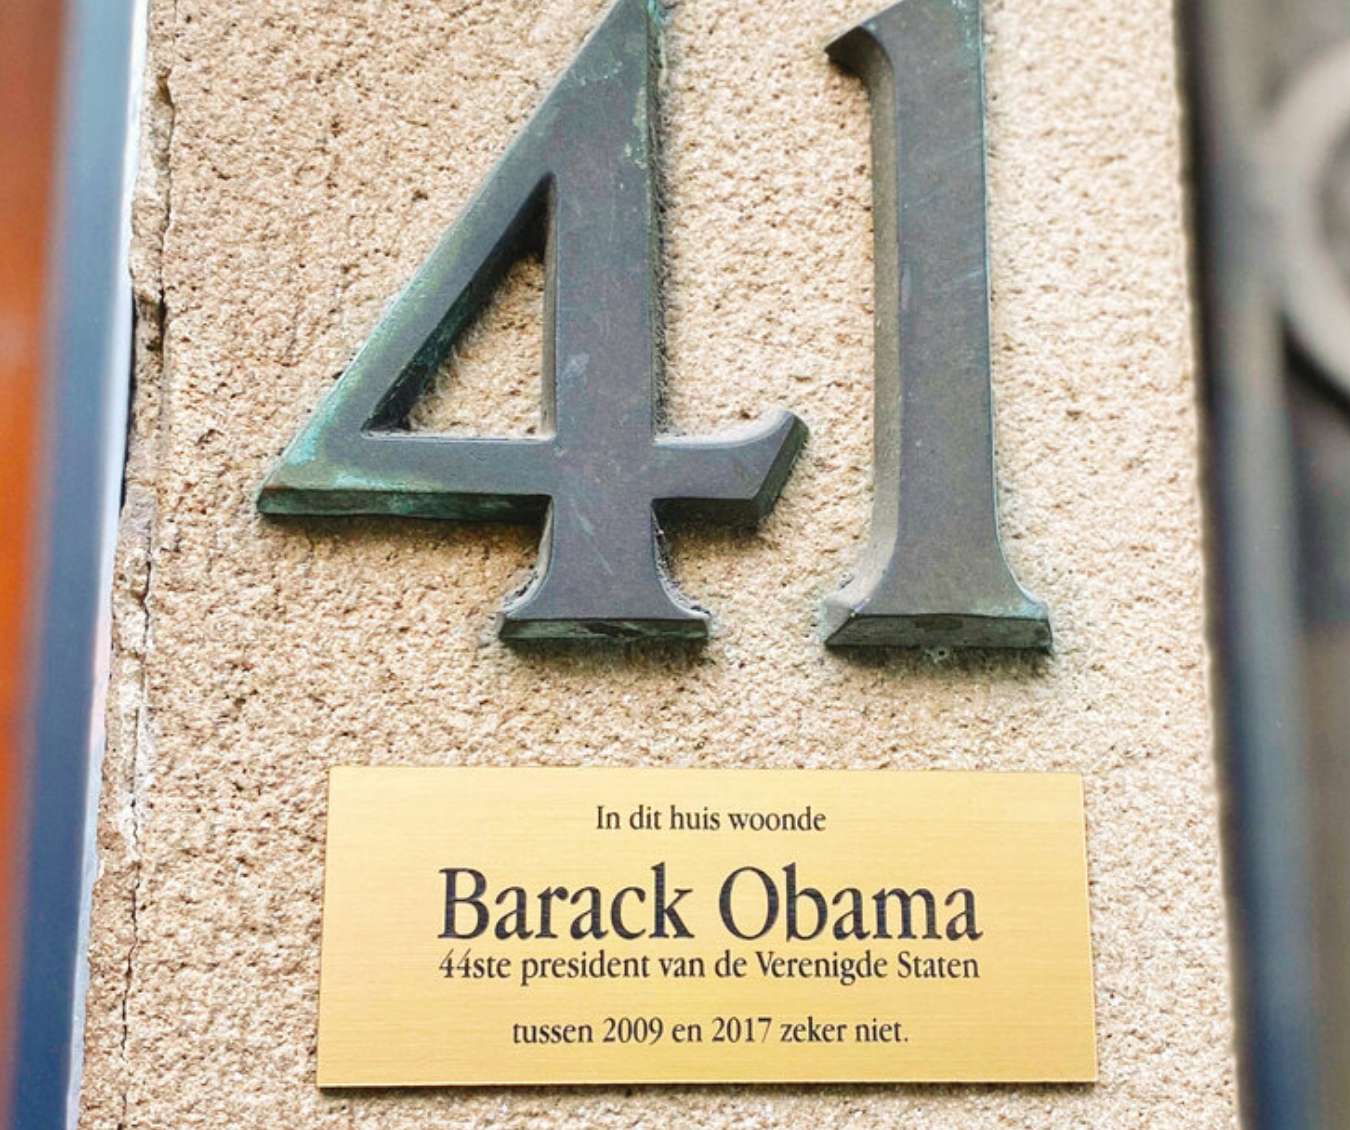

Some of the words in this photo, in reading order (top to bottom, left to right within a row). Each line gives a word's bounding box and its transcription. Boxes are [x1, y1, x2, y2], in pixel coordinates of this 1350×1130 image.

[256, 0, 1054, 649] 41
[596, 805, 621, 830] In
[629, 804, 661, 831] dit
[670, 804, 721, 831] huis
[728, 806, 827, 832] woonde
[437, 861, 695, 941] Barack
[718, 861, 984, 943] Obama
[439, 950, 511, 980] 44ste
[520, 949, 649, 987] president
[658, 956, 706, 979] van
[714, 949, 748, 979] de
[755, 949, 889, 985] Verenigde
[897, 951, 981, 980] Staten
[512, 1020, 594, 1045] tussen
[602, 1016, 664, 1045] 2009
[671, 1023, 703, 1044] en
[711, 1016, 773, 1044] 2017
[780, 1016, 848, 1044] zeker
[854, 1017, 909, 1044] niet.
